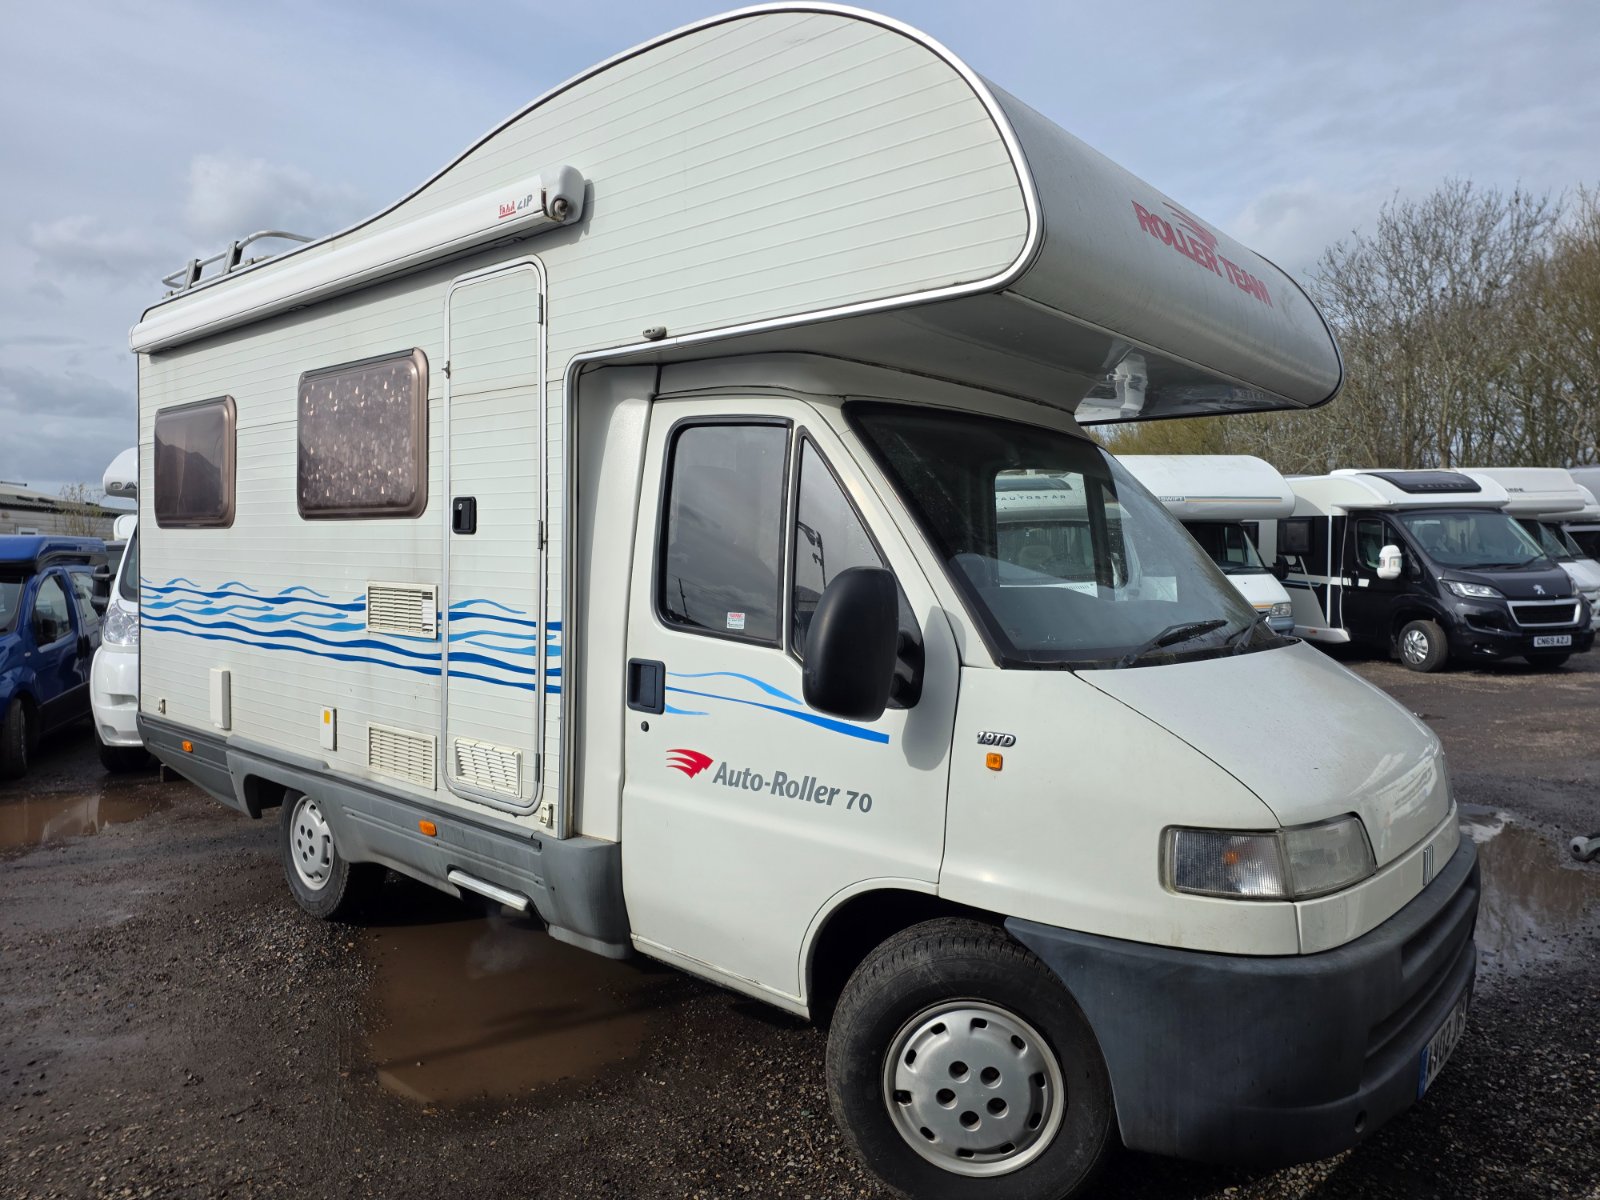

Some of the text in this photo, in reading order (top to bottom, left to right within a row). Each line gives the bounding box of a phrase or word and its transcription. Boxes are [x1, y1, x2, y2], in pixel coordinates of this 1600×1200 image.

[1131, 199, 1273, 309] ROLLER TEAM
[712, 761, 873, 813] Auto-Roller 70
